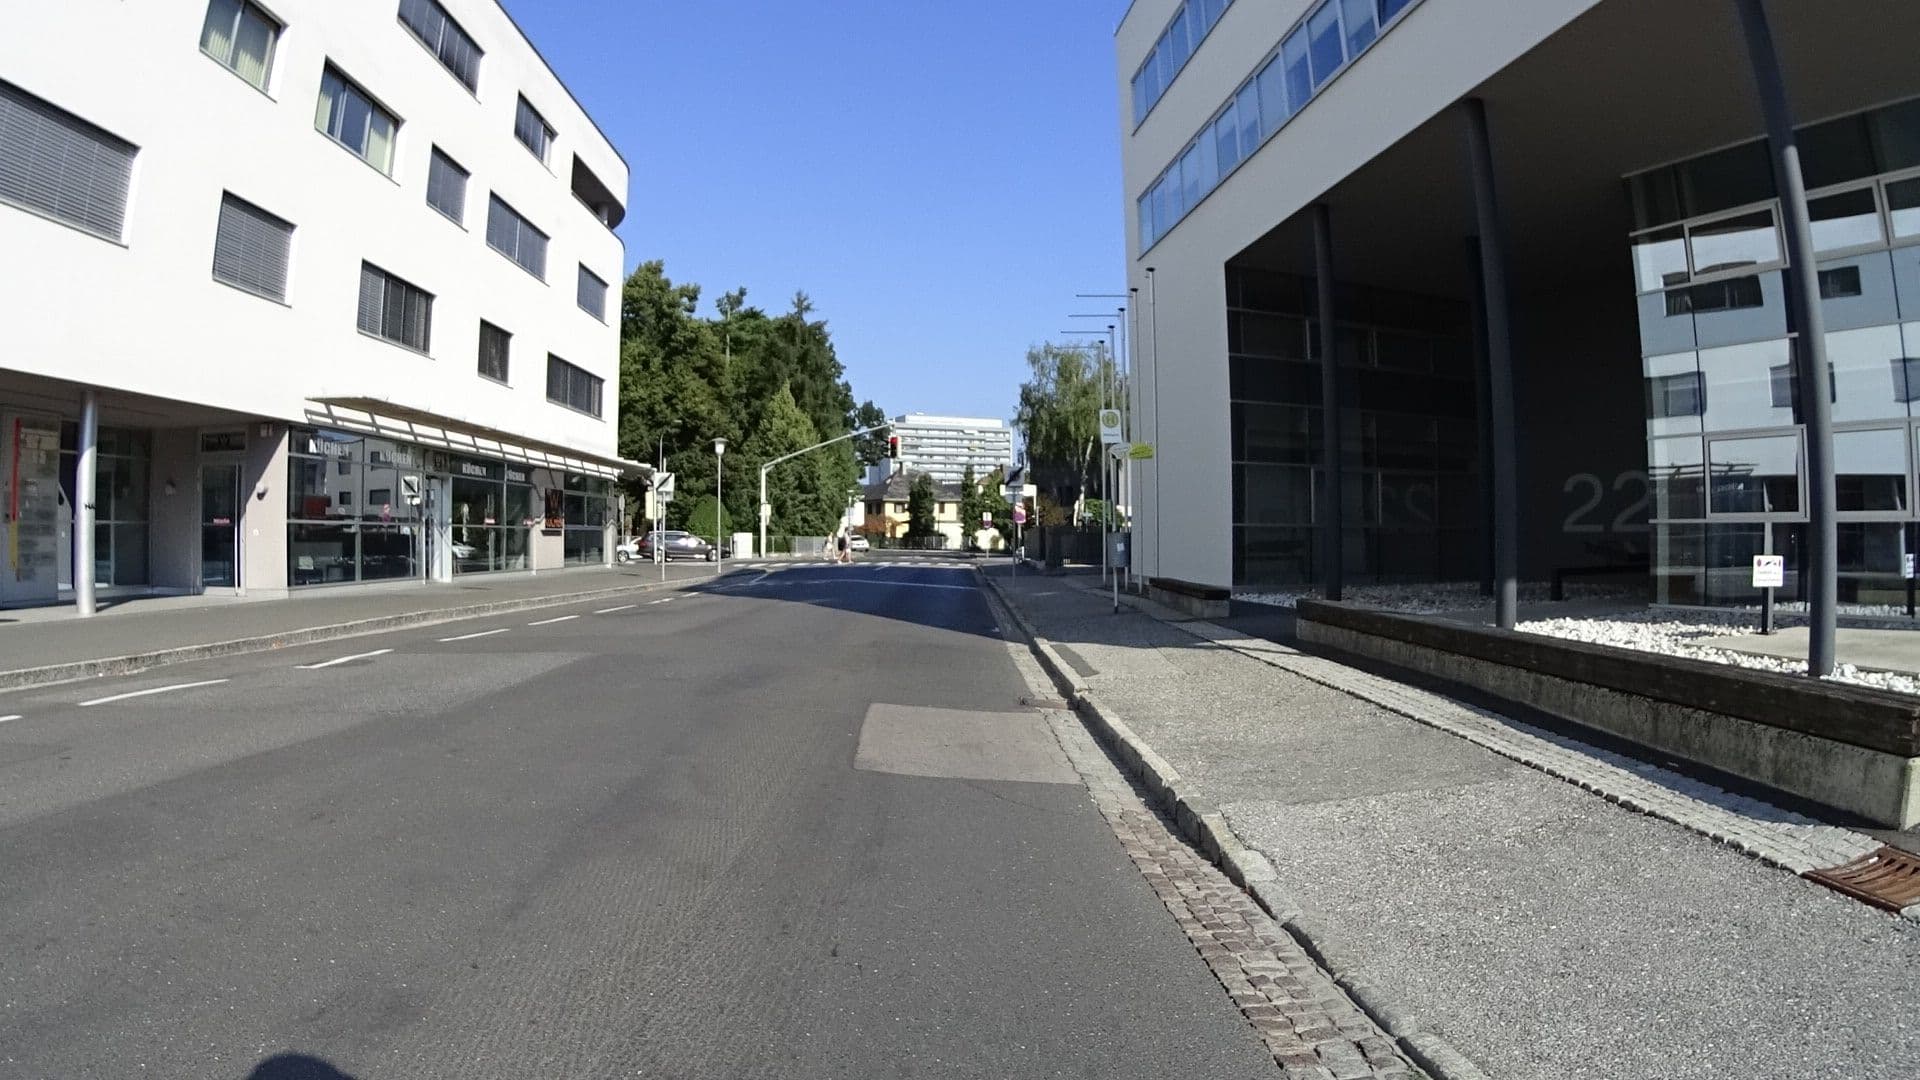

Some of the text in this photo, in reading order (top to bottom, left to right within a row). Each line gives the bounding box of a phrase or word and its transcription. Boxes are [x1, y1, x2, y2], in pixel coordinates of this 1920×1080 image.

[309, 438, 349, 457] KÜCHEN
[462, 463, 487, 477] KÜCHEN
[1563, 470, 1648, 532] 22
